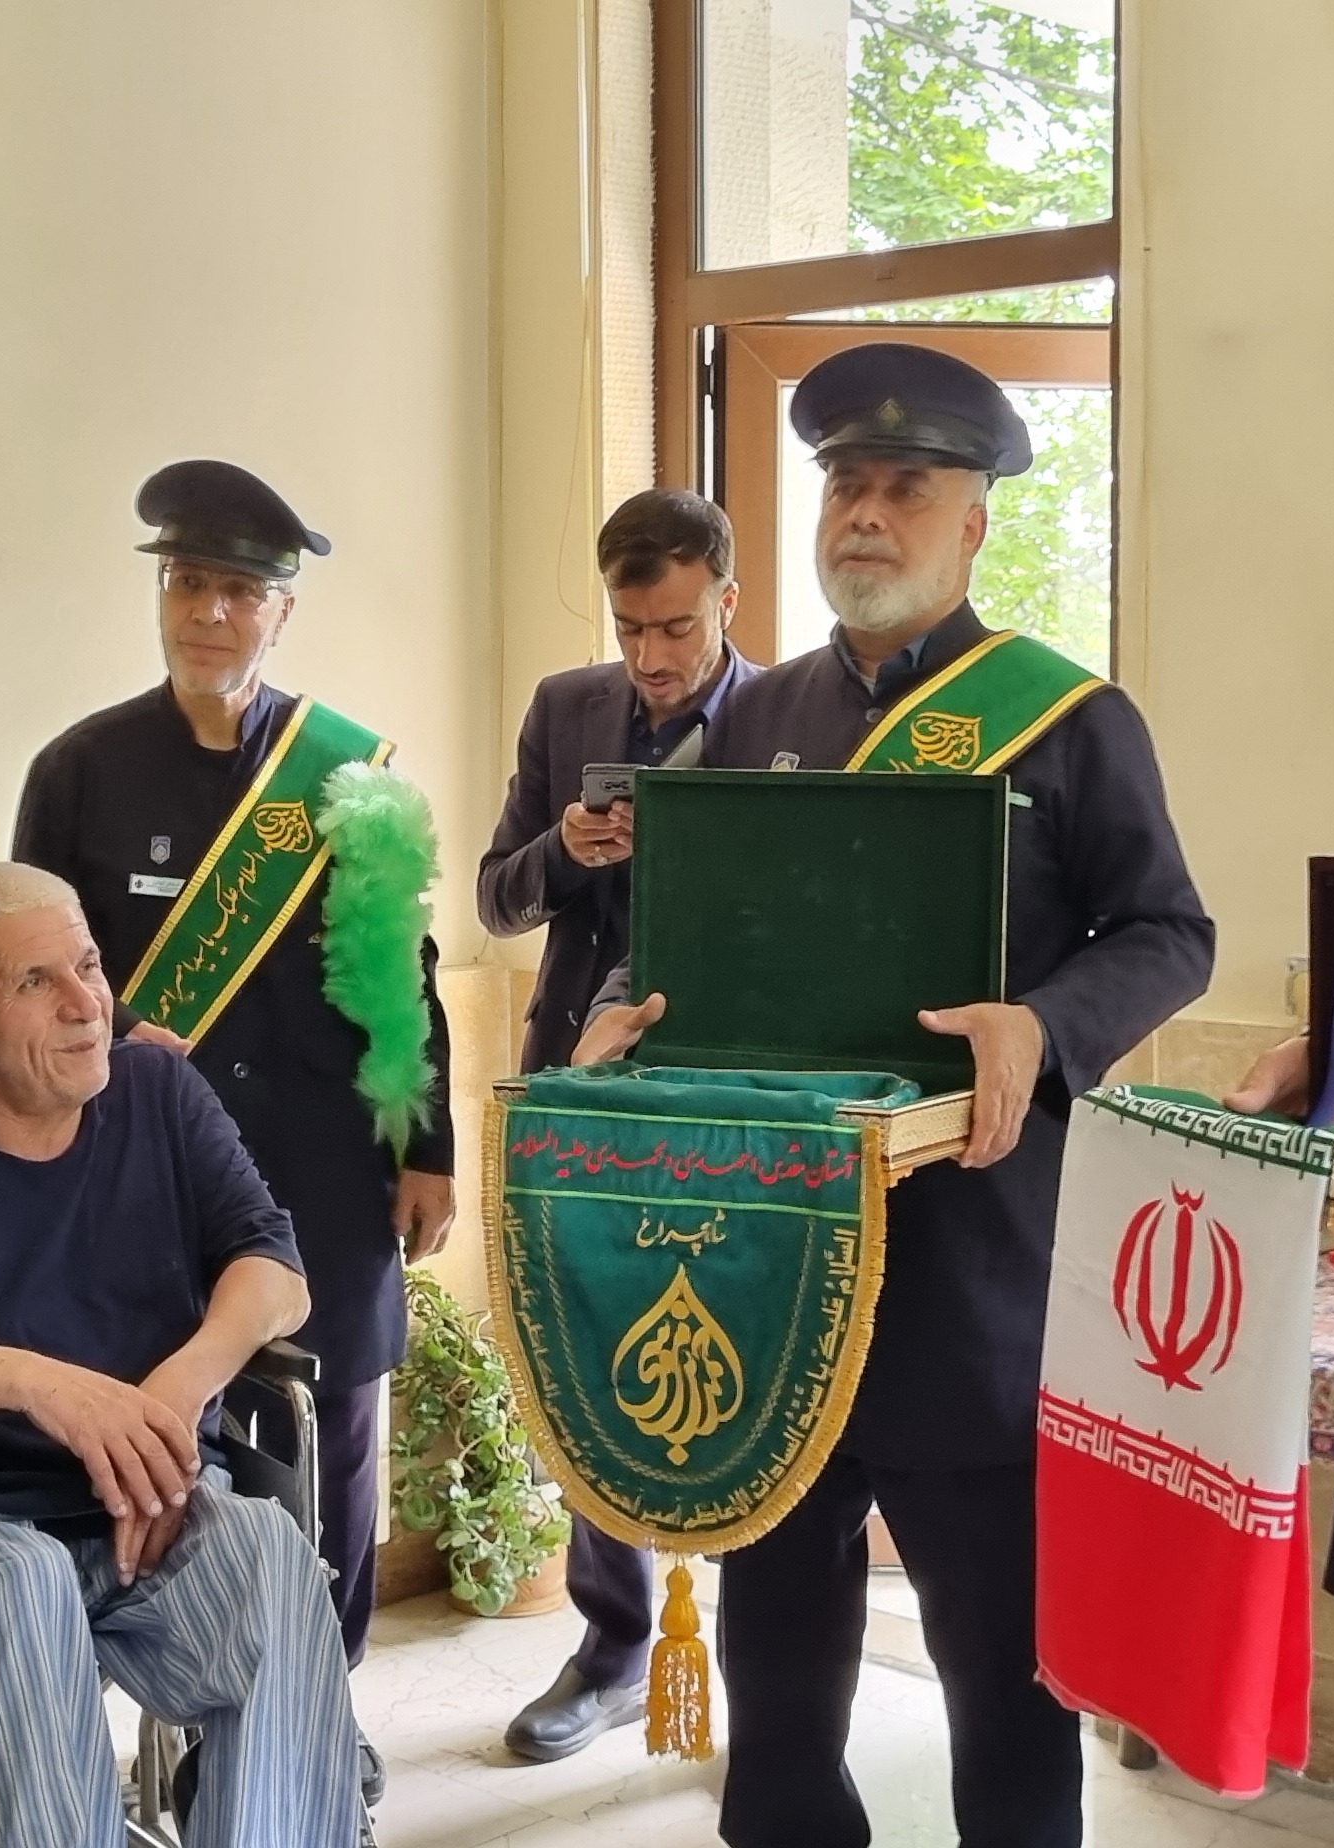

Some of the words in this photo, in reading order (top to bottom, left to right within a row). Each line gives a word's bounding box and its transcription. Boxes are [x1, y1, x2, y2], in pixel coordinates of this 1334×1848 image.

[238, 849, 269, 908] السلام
[212, 871, 251, 939] علیک
[583, 1140, 669, 1175] محمدی
[672, 1150, 758, 1182] احمدی
[756, 1144, 808, 1186] مقدس
[804, 1148, 861, 1189] آستان
